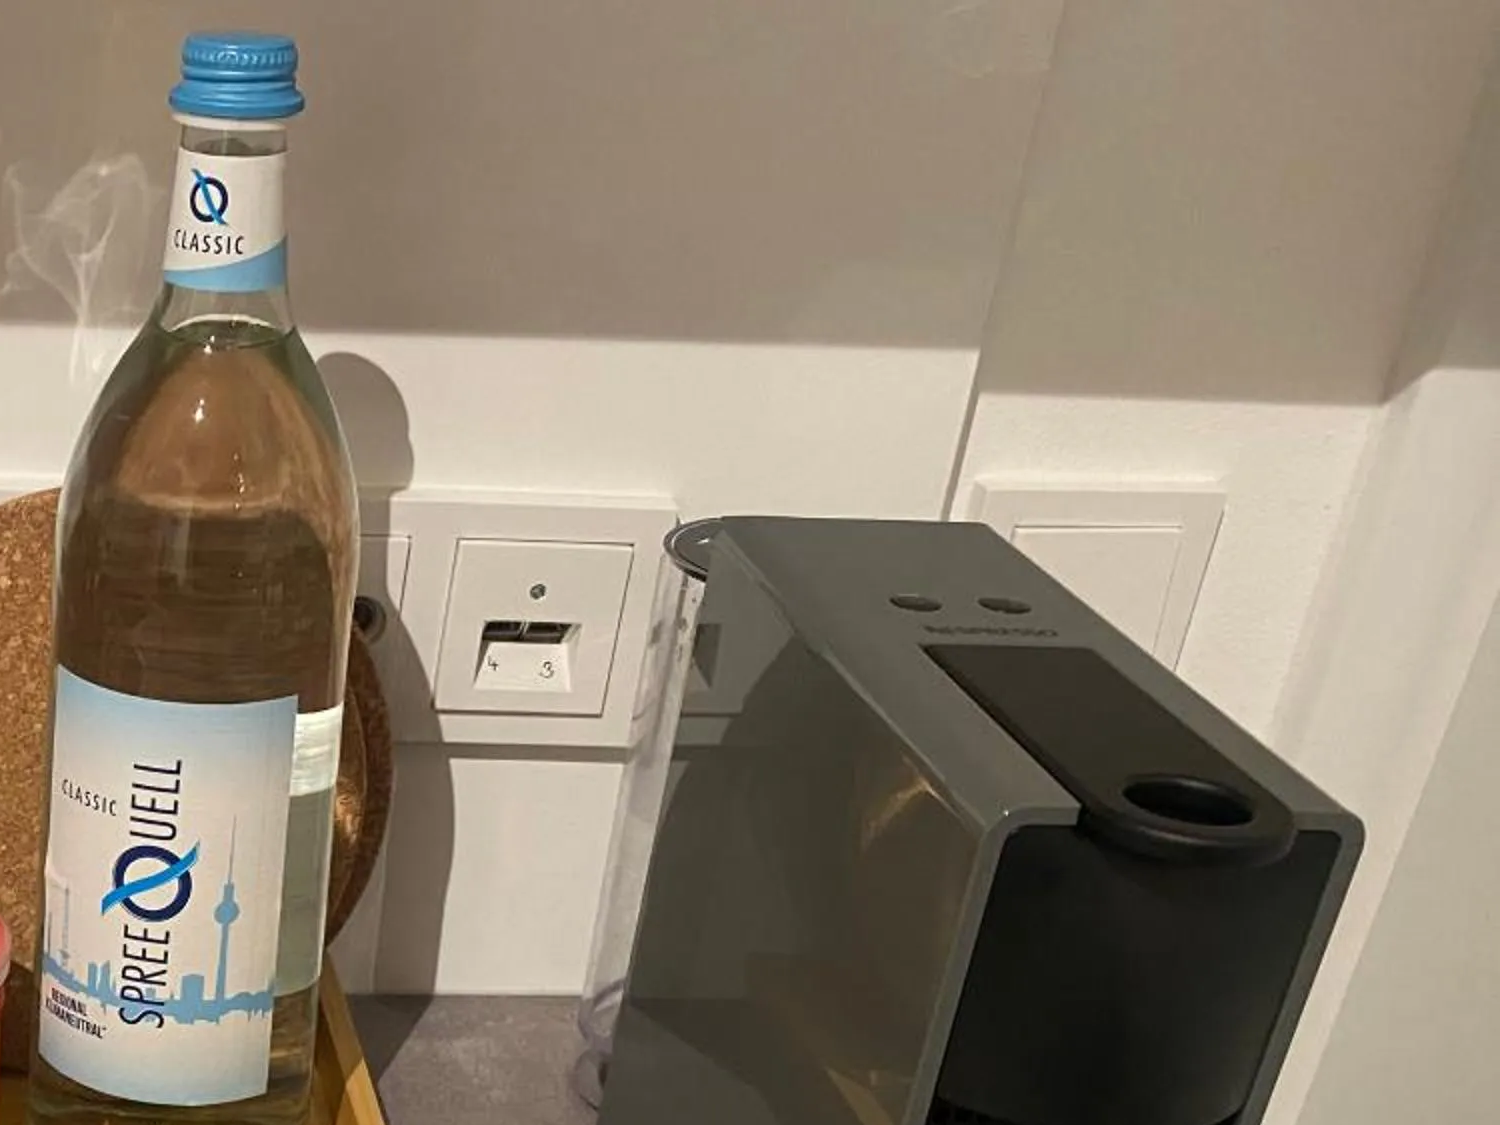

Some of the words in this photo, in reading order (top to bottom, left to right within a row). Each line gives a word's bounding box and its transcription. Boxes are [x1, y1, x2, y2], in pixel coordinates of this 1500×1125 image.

[173, 229, 245, 255] CLASSIC
[487, 656, 499, 672] 4
[539, 661, 555, 679] 3
[61, 778, 117, 817] CLASSIC
